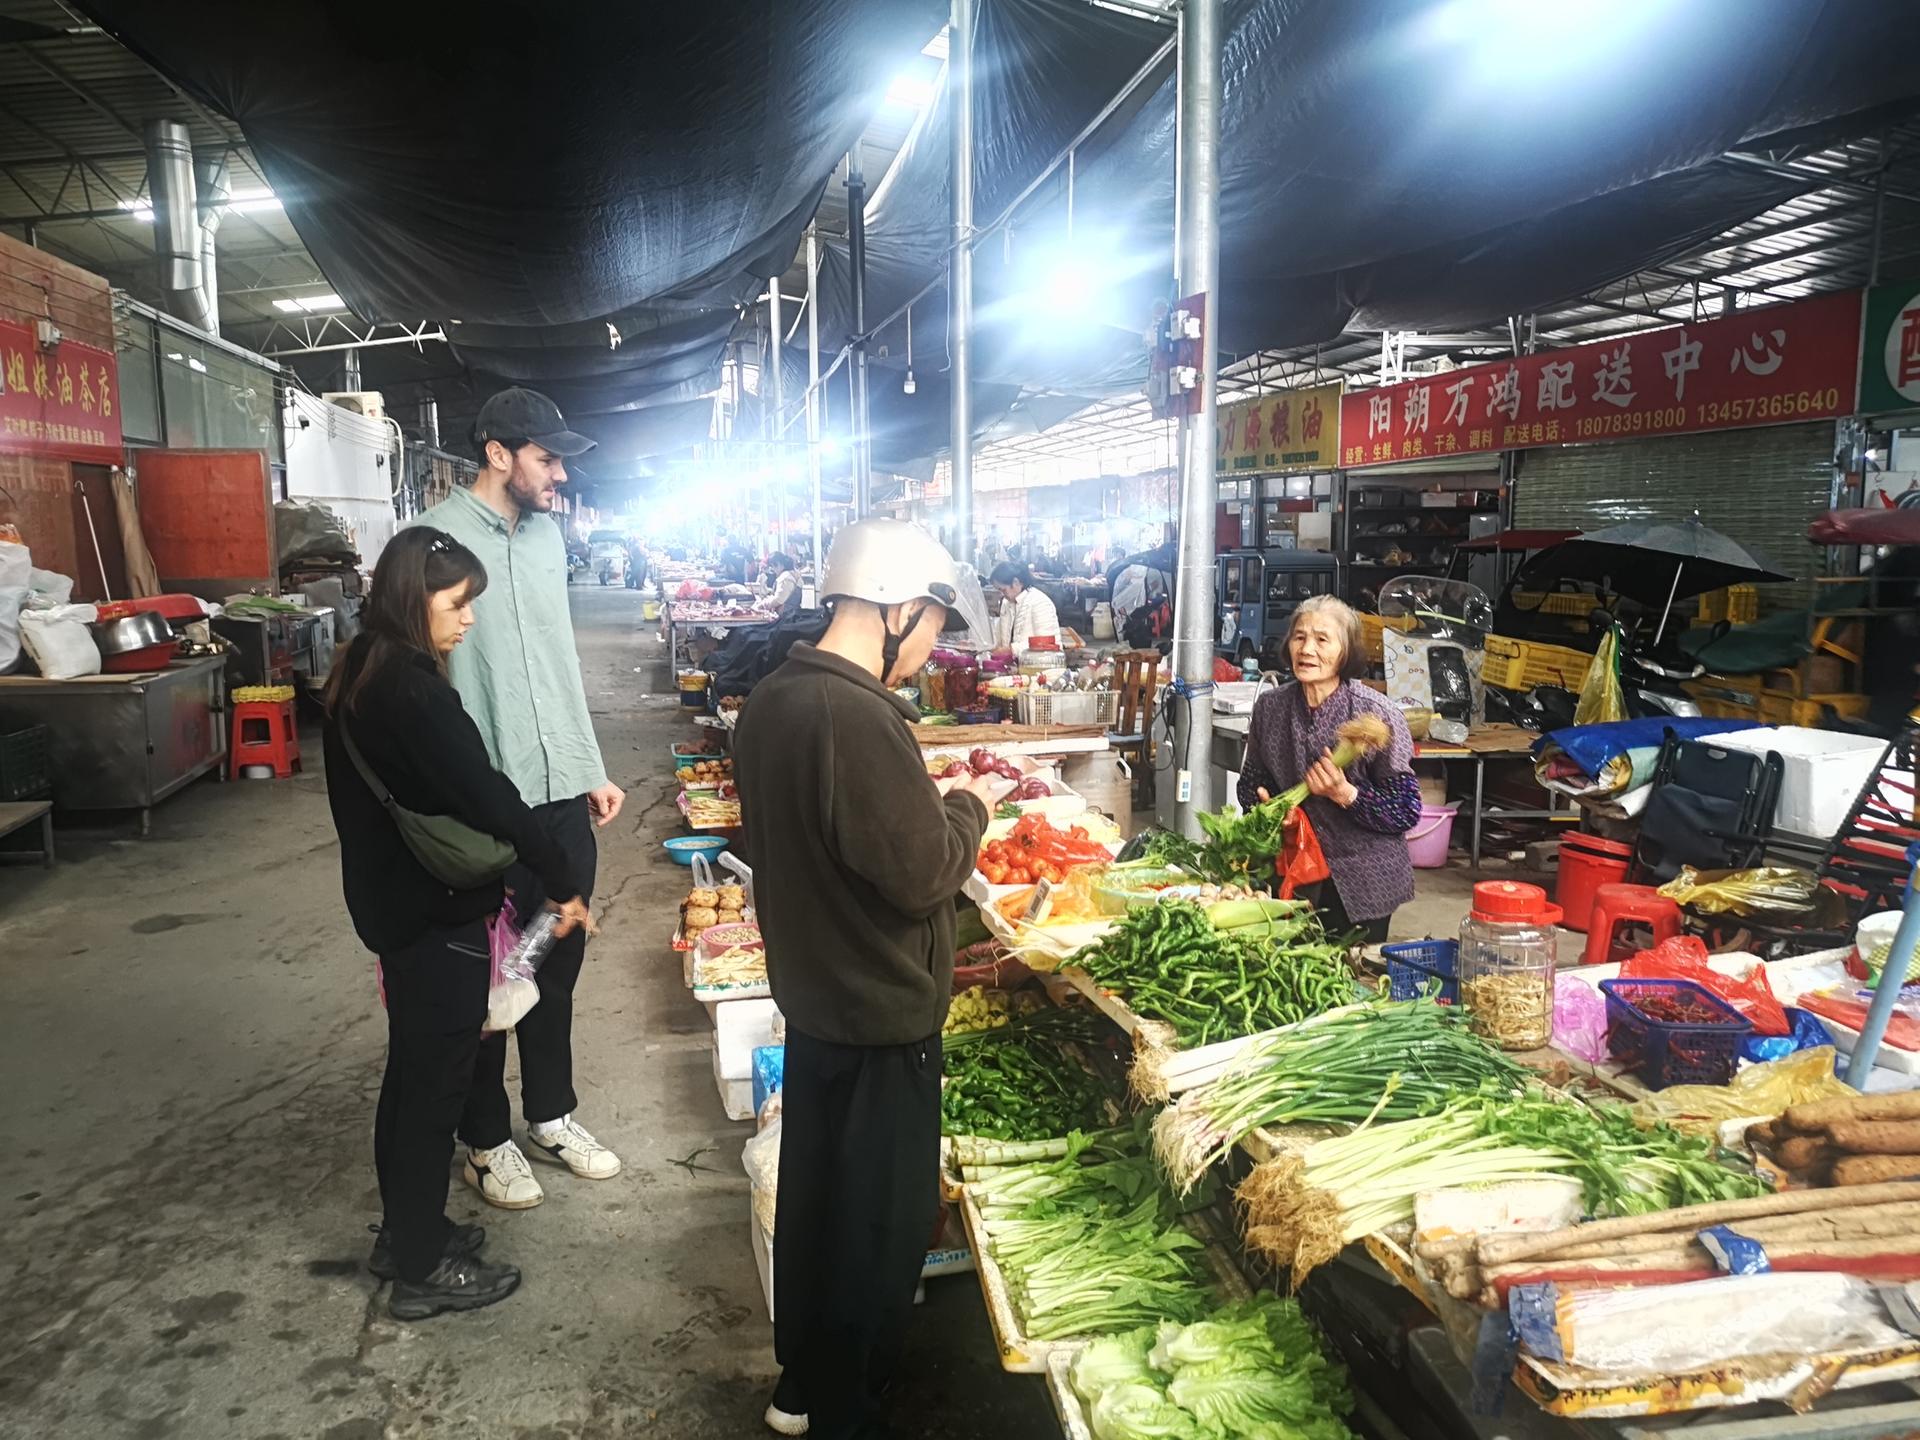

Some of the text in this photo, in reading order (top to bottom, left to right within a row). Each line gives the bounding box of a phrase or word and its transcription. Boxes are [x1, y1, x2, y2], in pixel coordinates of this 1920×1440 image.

[6, 345, 112, 417] 姐妹油茶店
[1368, 329, 1787, 440] 阳朔万鸿配送中心
[1575, 407, 1686, 437] 18078391800
[1697, 388, 1839, 424] 13457365640
